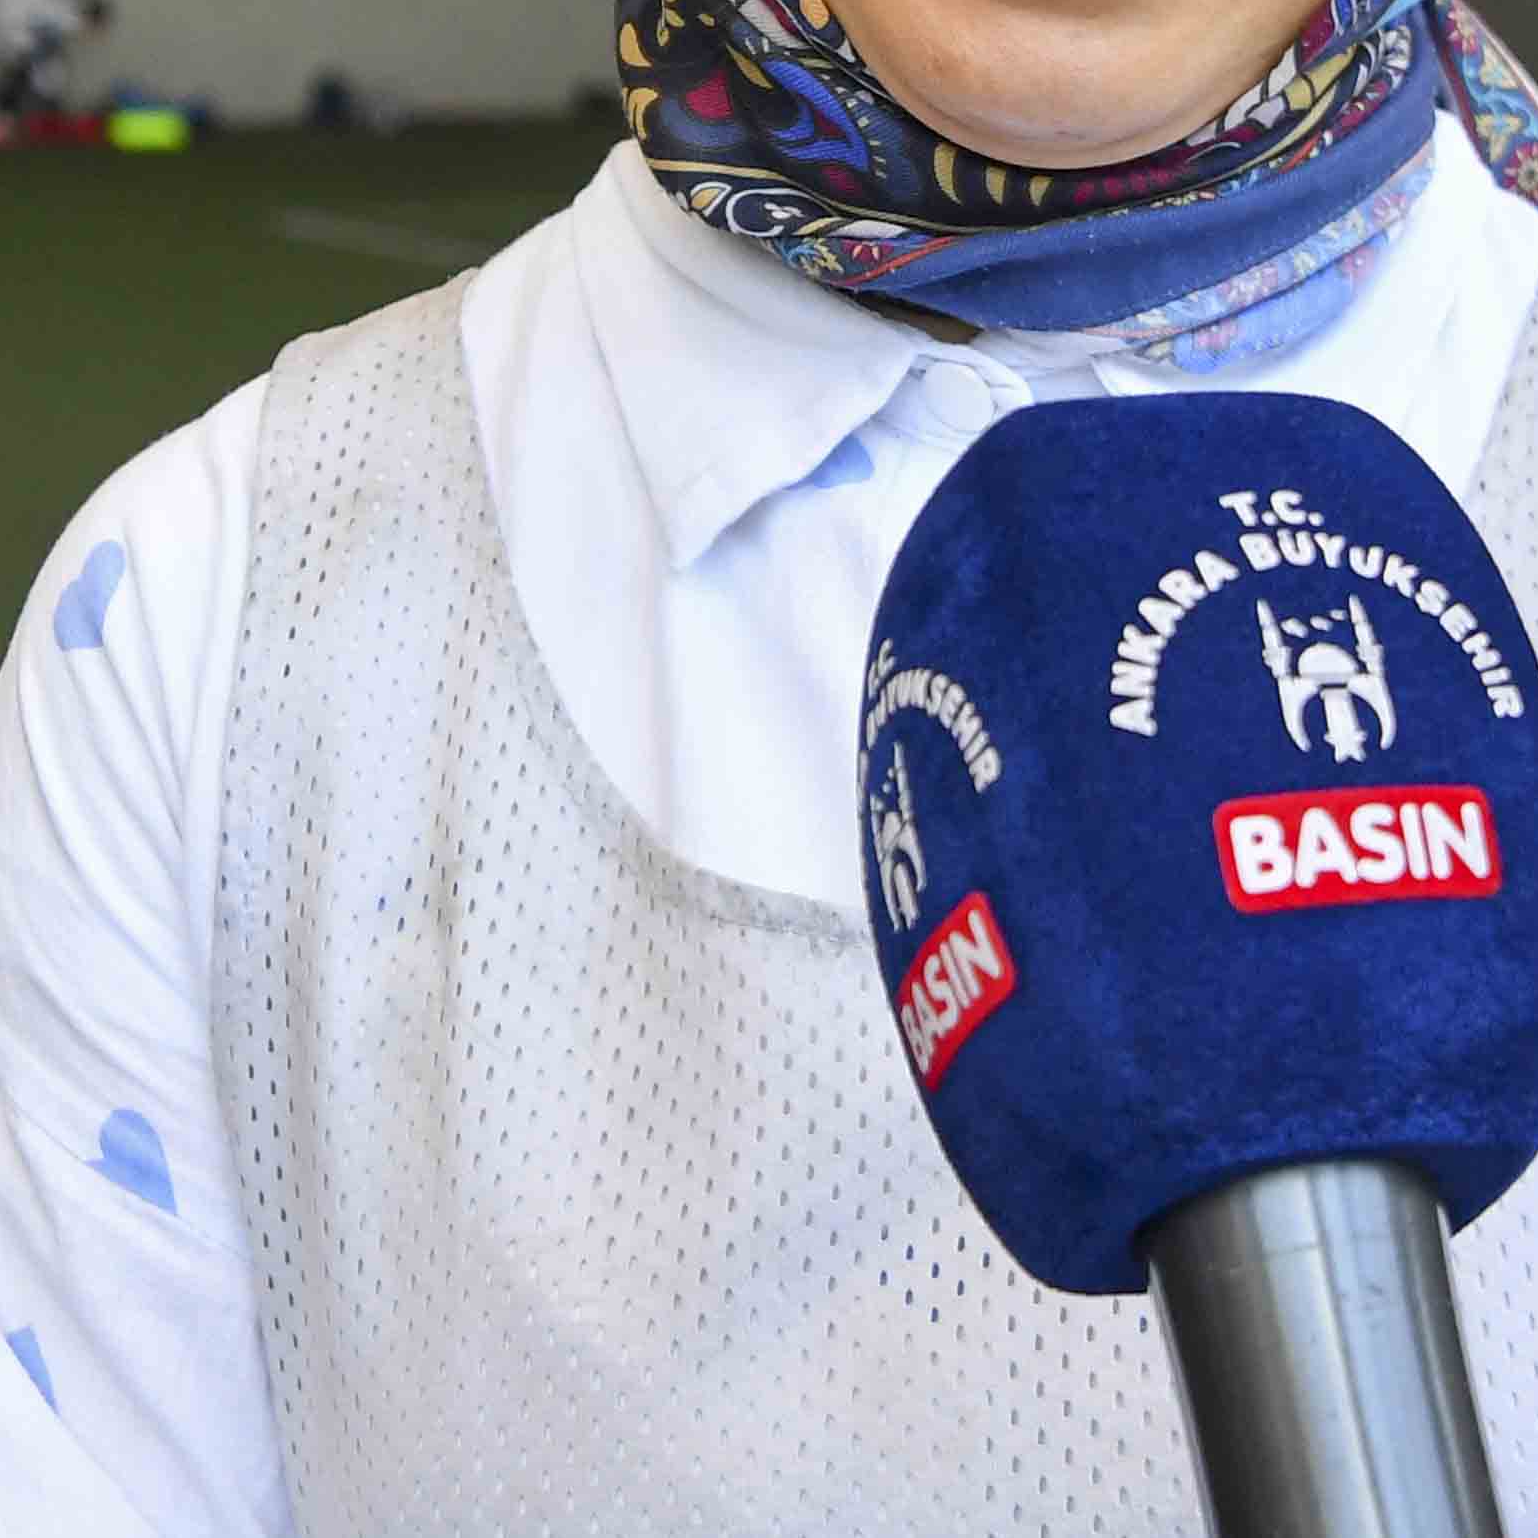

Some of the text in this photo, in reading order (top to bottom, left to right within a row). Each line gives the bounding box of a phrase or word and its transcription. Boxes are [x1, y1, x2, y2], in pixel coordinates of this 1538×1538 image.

[1218, 488, 1325, 528] T.C.
[1108, 549, 1241, 738] ANKARA
[1229, 801, 1492, 896] BASIN
[899, 909, 1004, 1074] BASIN
